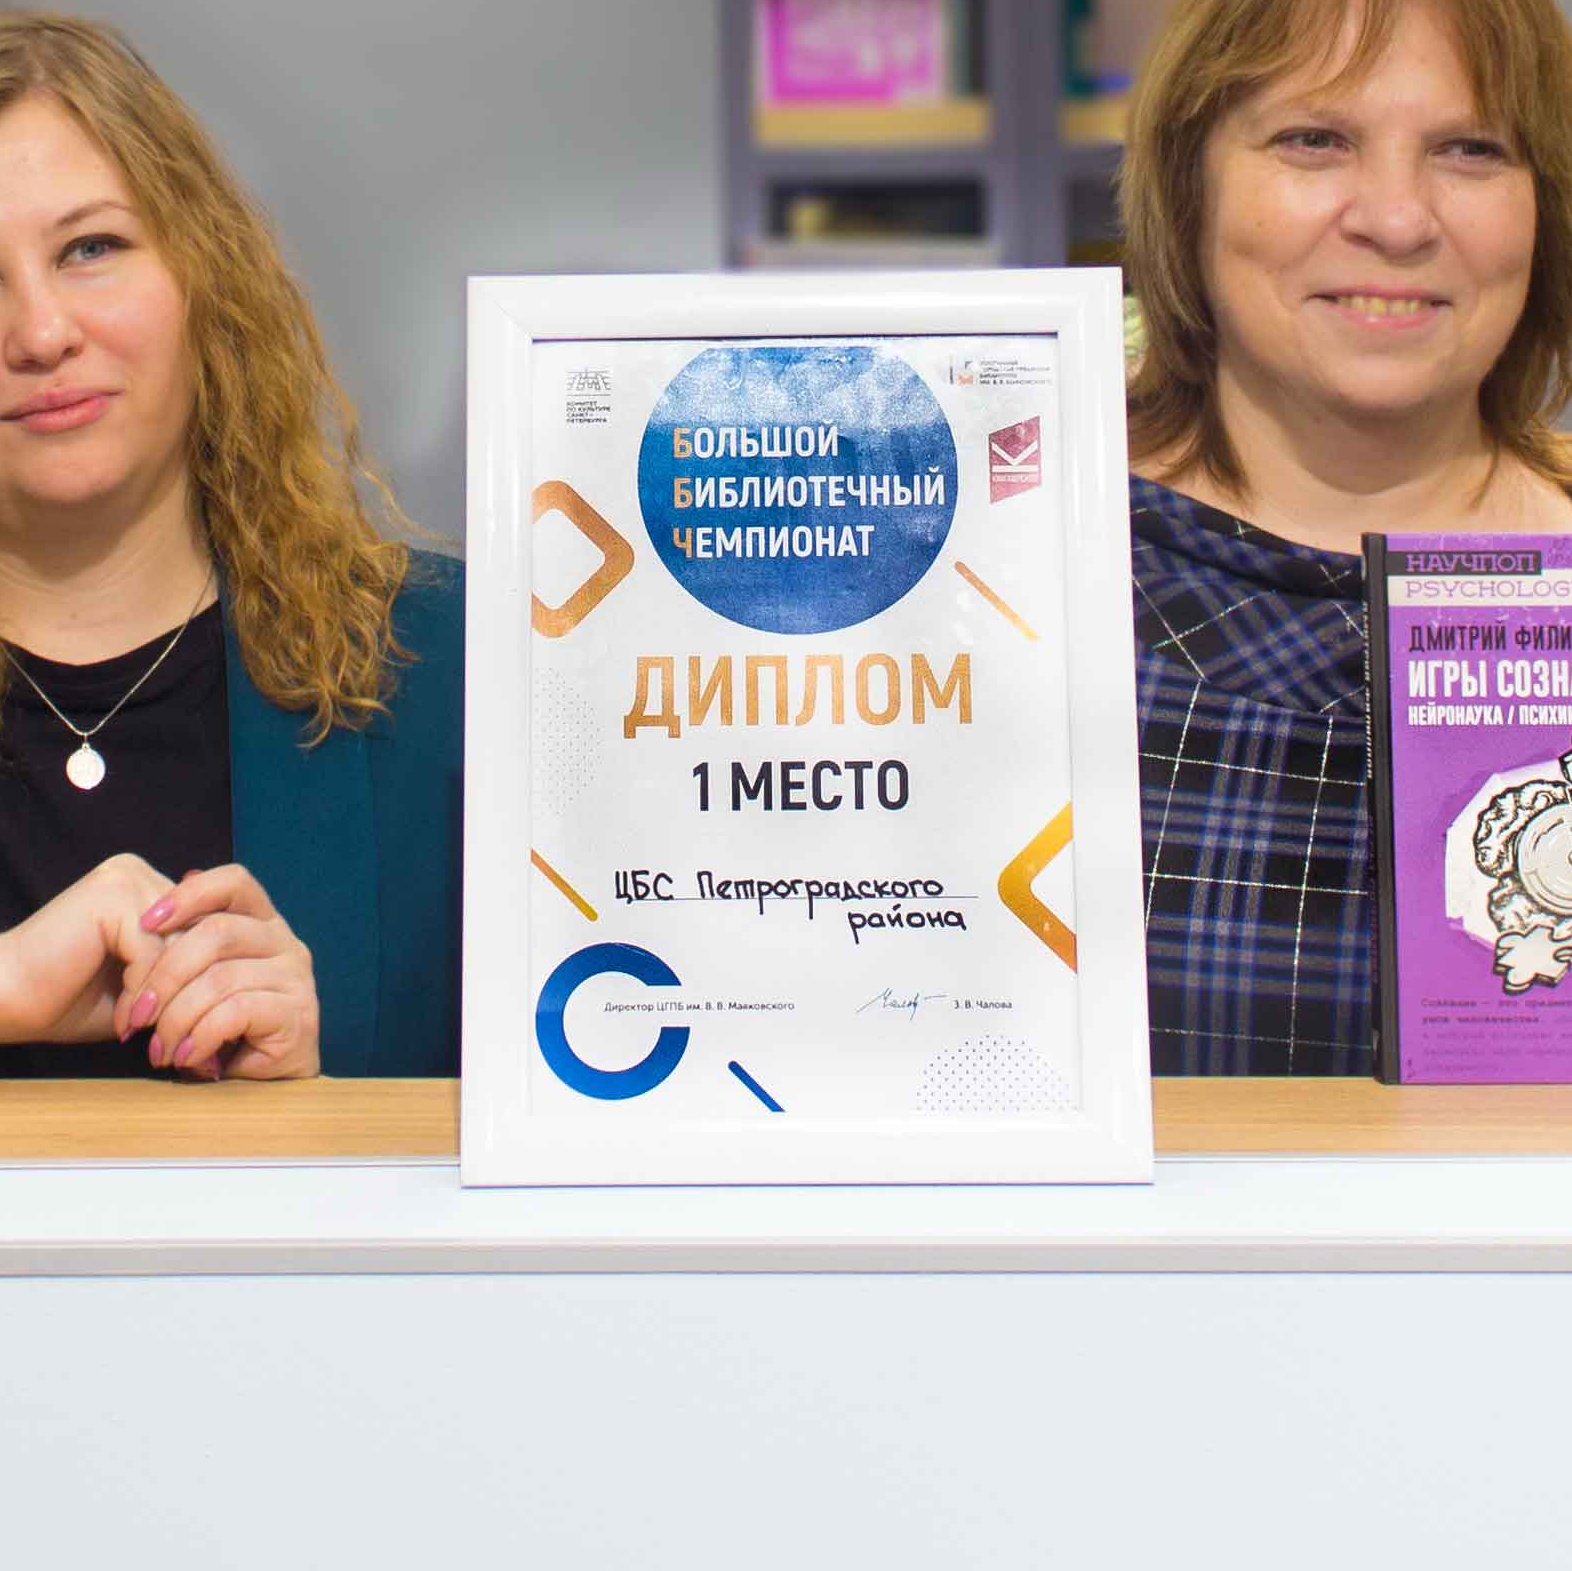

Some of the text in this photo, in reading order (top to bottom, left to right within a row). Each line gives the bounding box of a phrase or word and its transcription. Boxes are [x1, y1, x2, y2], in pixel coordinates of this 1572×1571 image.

[672, 418, 839, 459] БОЛЬШОЙ
[673, 466, 945, 509] БИБЛИОТЕЧНЫЙ
[672, 524, 875, 559] ЧЕМПИОНАТ
[1404, 553, 1535, 573] НАУЧПОП
[1408, 620, 1507, 653] ДМИТРИЙ
[623, 652, 973, 739] ДИПЛОМ
[1408, 659, 1488, 698] ИГРЫ
[1407, 701, 1504, 726] НЕЙРОНАУКА
[692, 759, 910, 812] 1 МЕСТО
[614, 869, 945, 920] ЦБС Петроградского
[847, 903, 968, 945] района
[604, 1001, 795, 1013] Директор ЦГПБ им. В. В. Маяковского
[964, 999, 974, 1010] В.
[976, 999, 1014, 1010] Чалова
